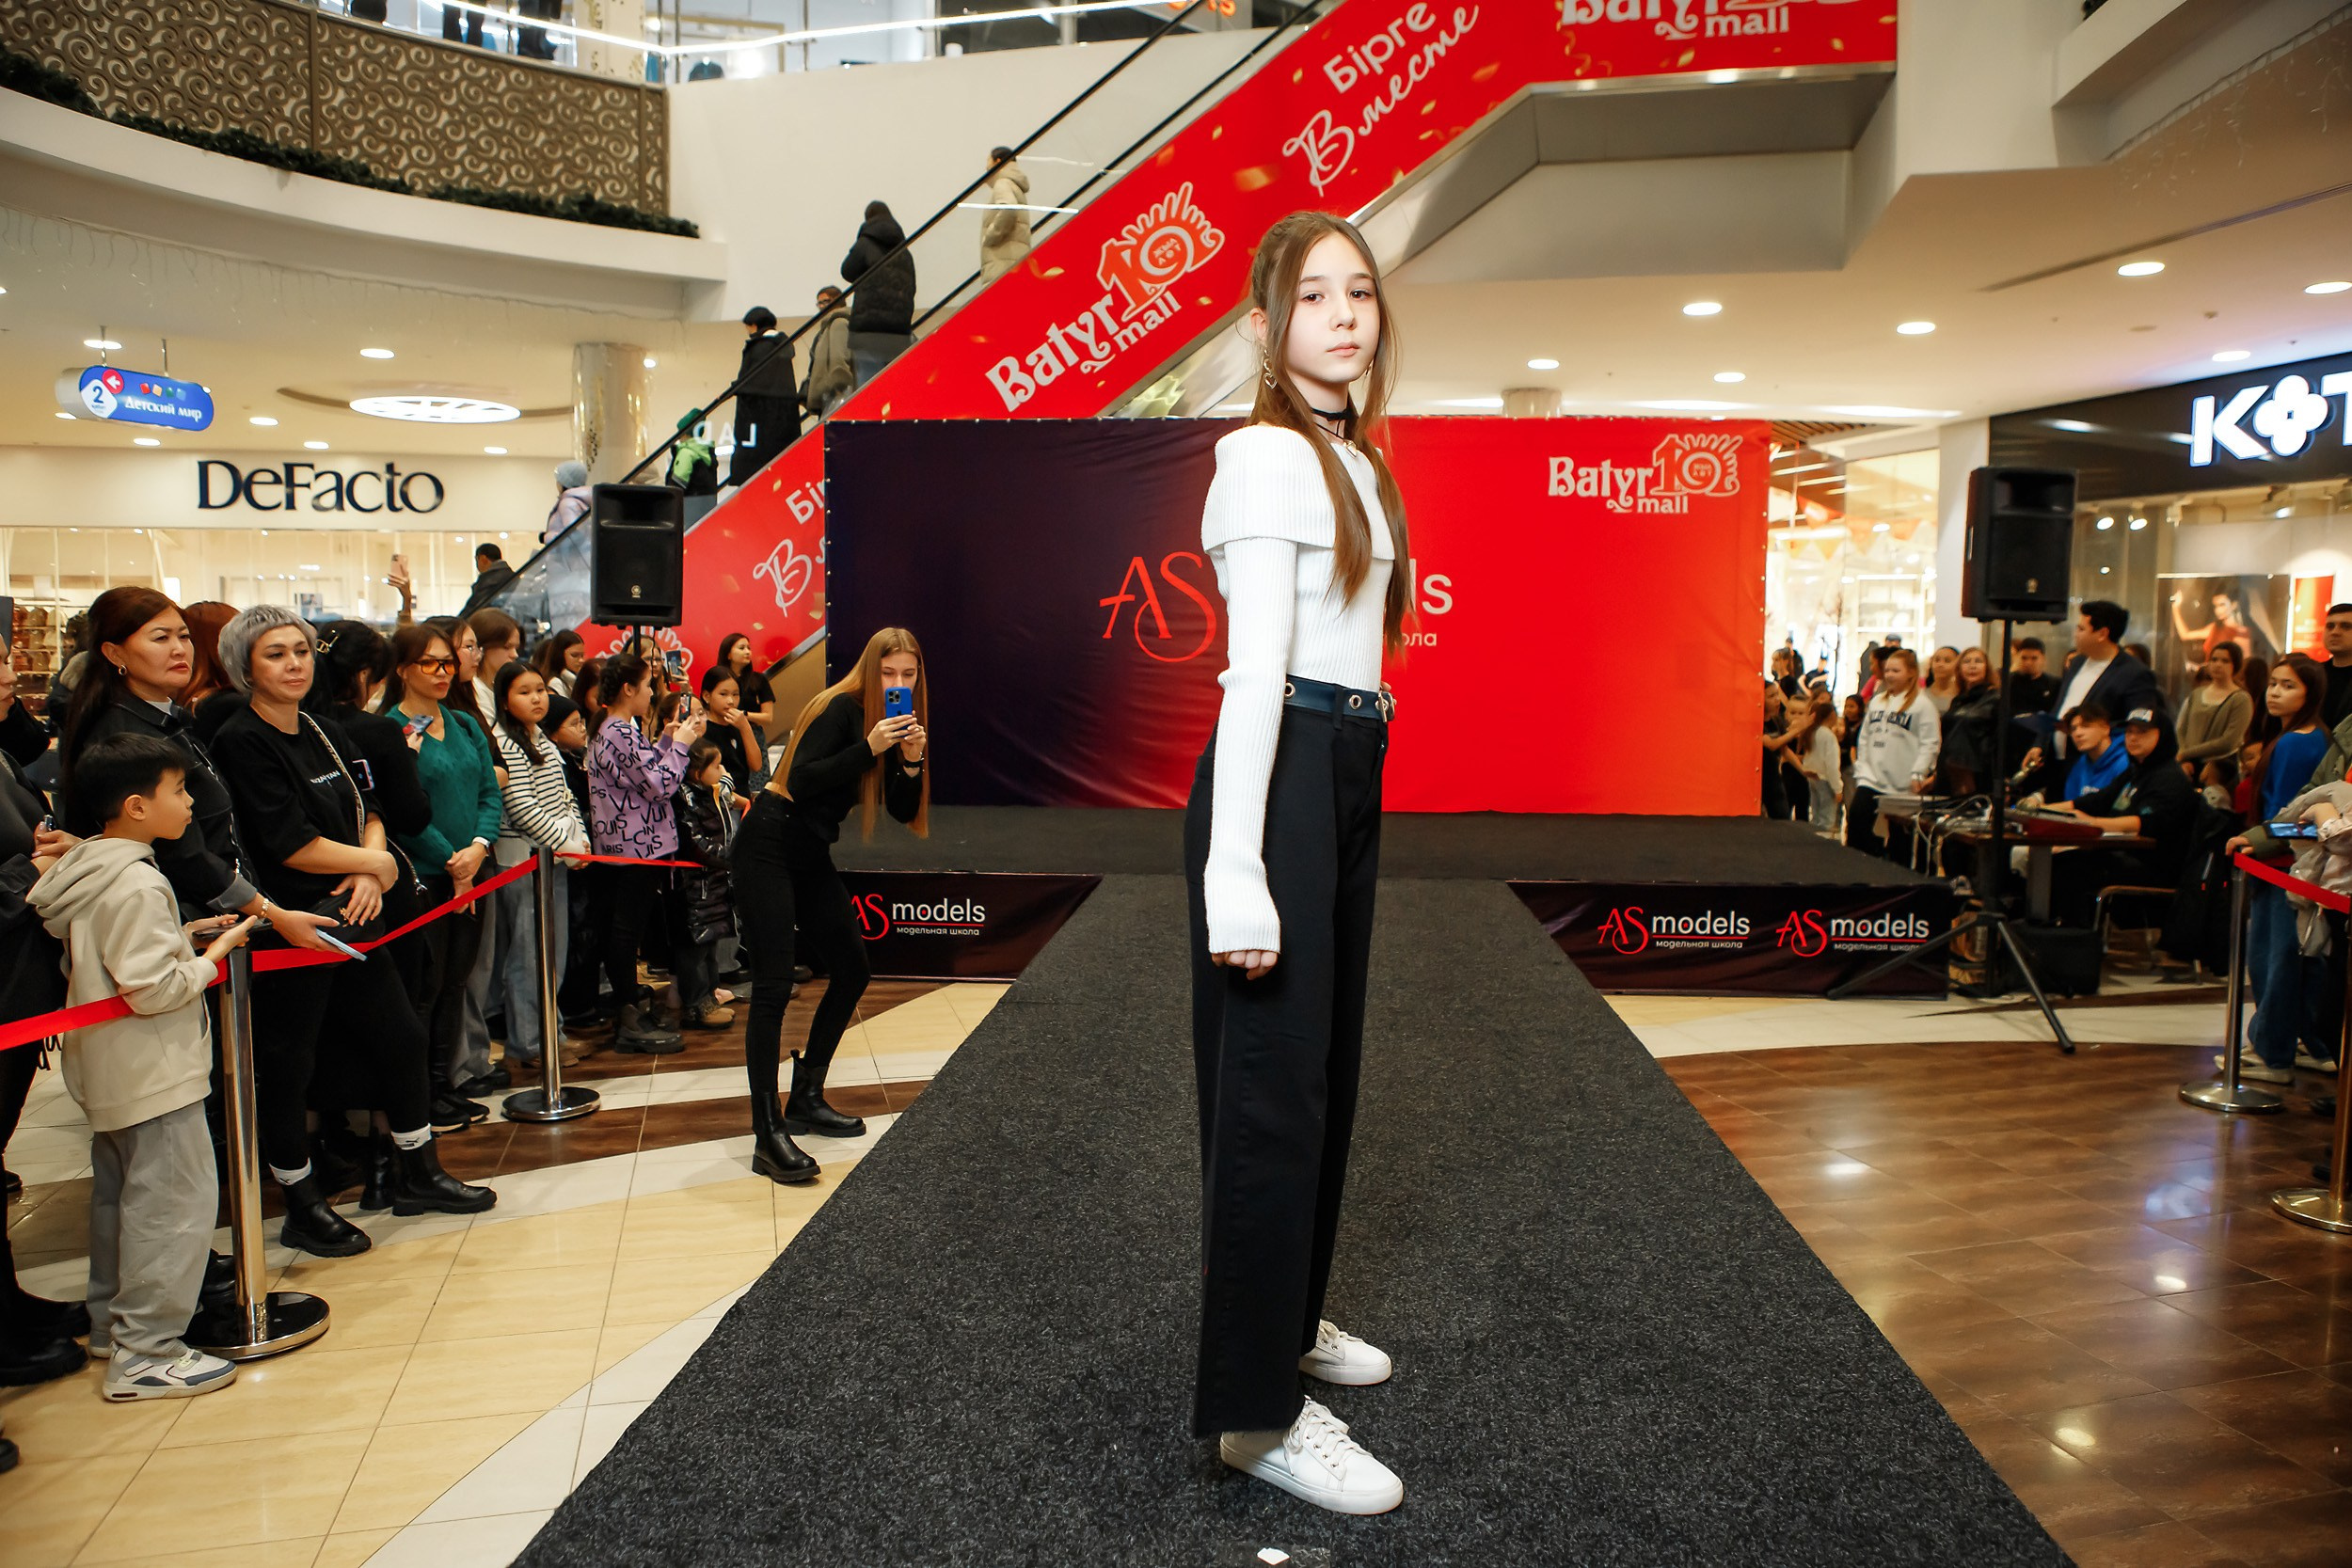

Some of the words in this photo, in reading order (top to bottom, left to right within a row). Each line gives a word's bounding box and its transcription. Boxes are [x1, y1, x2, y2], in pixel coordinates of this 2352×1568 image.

[1704, 8, 1789, 38] mall
[1323, 2, 1437, 94] Бірге
[1114, 291, 1182, 352] mall
[985, 293, 1120, 413] Batyr
[92, 385, 104, 404] 2
[125, 396, 175, 416] Детский
[177, 406, 202, 422] мир
[197, 460, 444, 514] DeFacto
[1548, 455, 1655, 514] Batyr
[1637, 493, 1689, 514] mall
[1099, 551, 1217, 662] AS
[892, 898, 986, 923] models
[897, 927, 948, 936] модельная
[949, 928, 980, 937] школа
[1597, 906, 1649, 955] AS
[1651, 910, 1751, 935] models
[1775, 909, 1828, 958] AS
[1830, 912, 1930, 939] models
[1656, 941, 1709, 949] модельная
